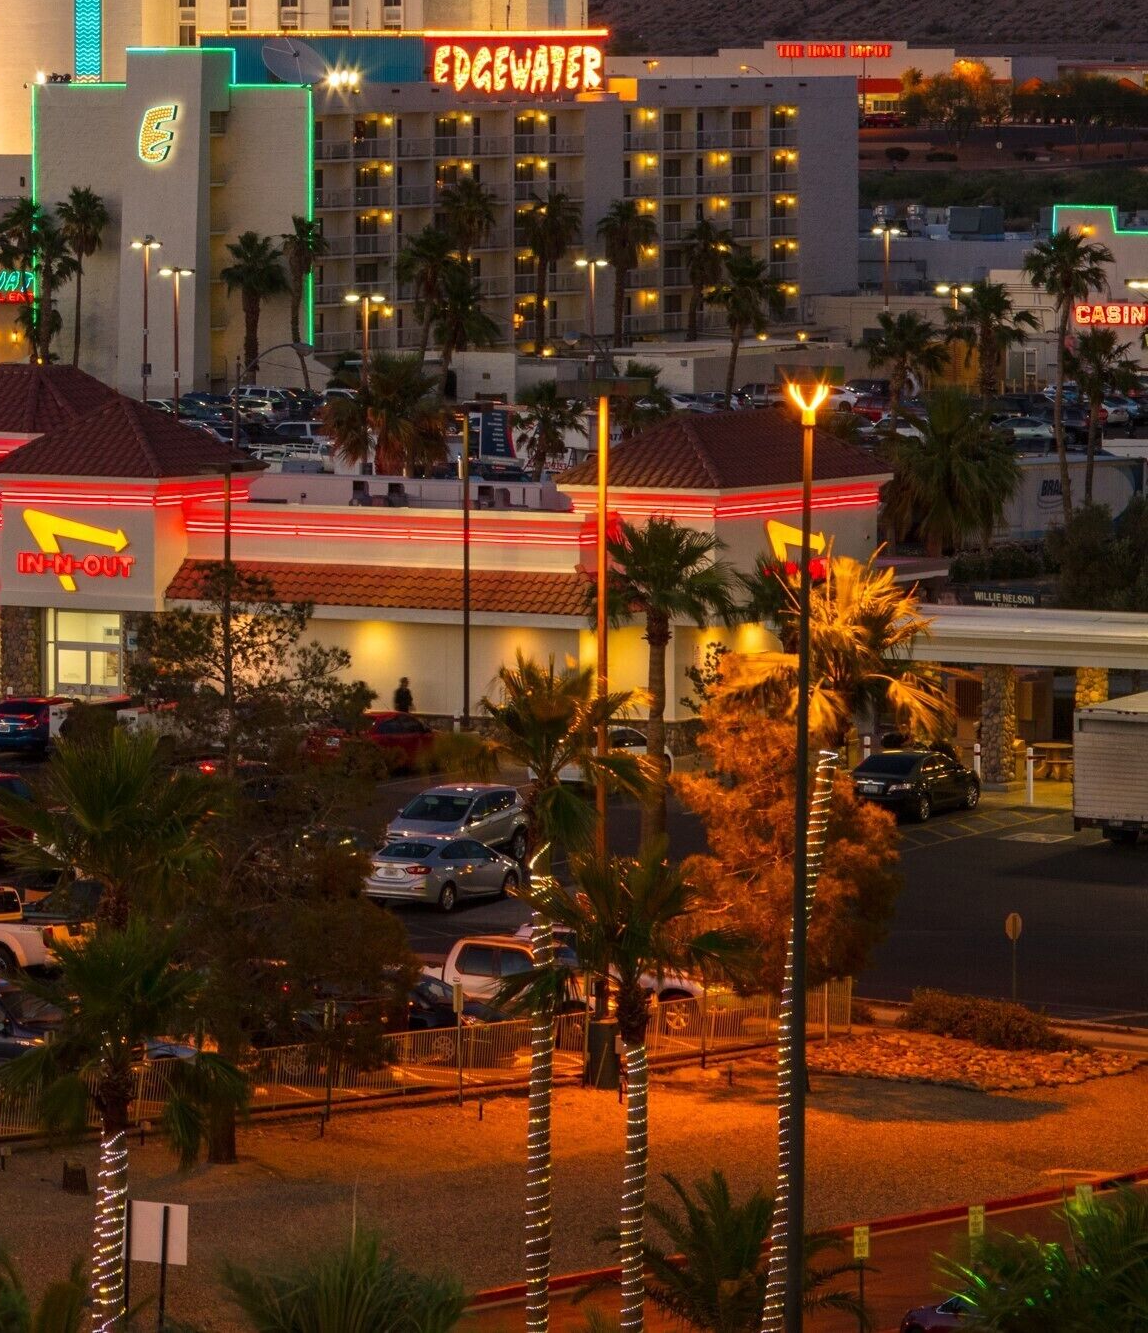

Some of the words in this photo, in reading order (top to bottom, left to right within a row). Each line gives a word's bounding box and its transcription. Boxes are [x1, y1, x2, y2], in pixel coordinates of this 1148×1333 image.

[778, 45, 802, 57] THE
[807, 45, 844, 57] HOME
[850, 45, 892, 57] DEPOT
[433, 44, 602, 93] EDGEWATER
[18, 552, 135, 577] IN-N-OUT
[974, 591, 1001, 601] WILLIE
[1002, 593, 1035, 604] NELSON
